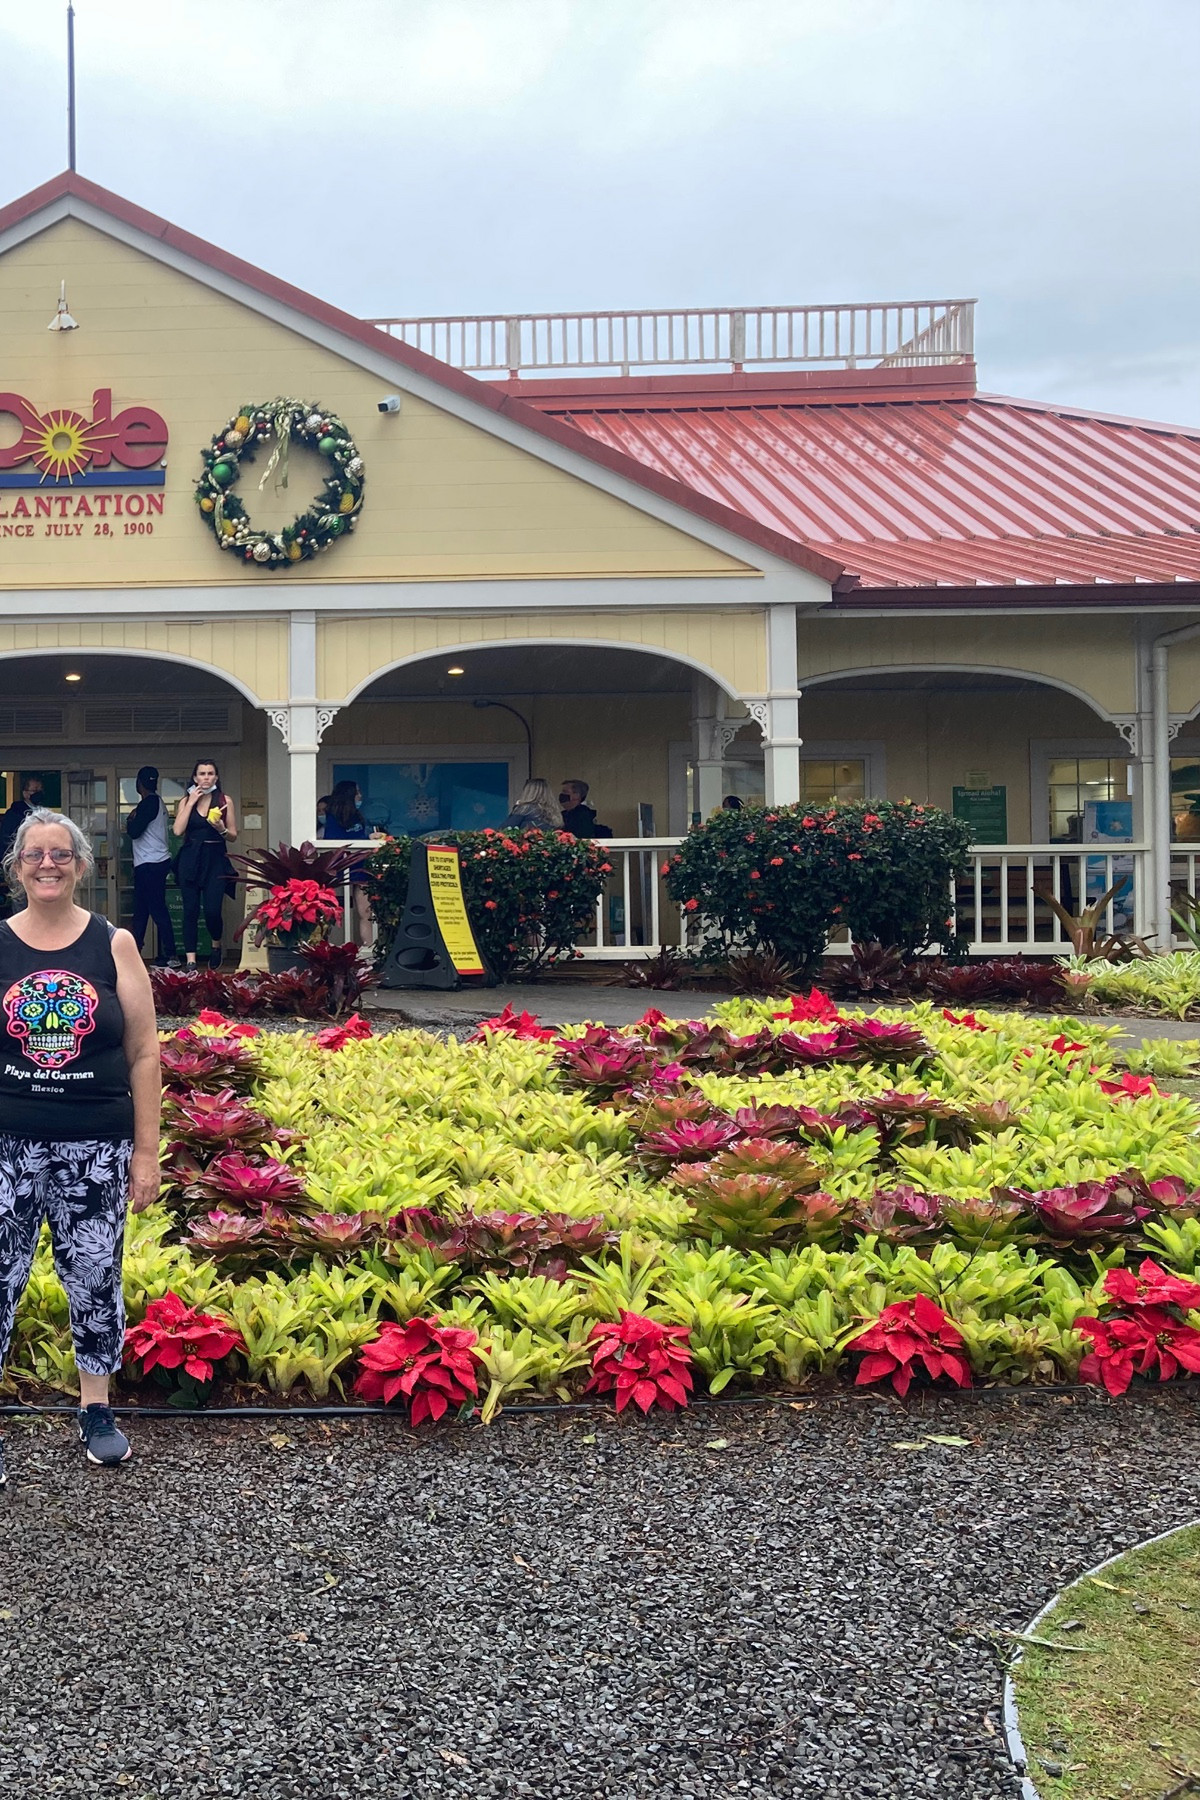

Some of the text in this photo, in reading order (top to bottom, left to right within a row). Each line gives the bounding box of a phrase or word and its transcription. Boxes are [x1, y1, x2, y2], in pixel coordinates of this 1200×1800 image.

[44, 523, 84, 537] JULY
[94, 523, 114, 538] 28,
[123, 522, 154, 535] 1900
[4, 1064, 94, 1080] Playa del Carmen
[31, 1084, 65, 1093] Mexico
